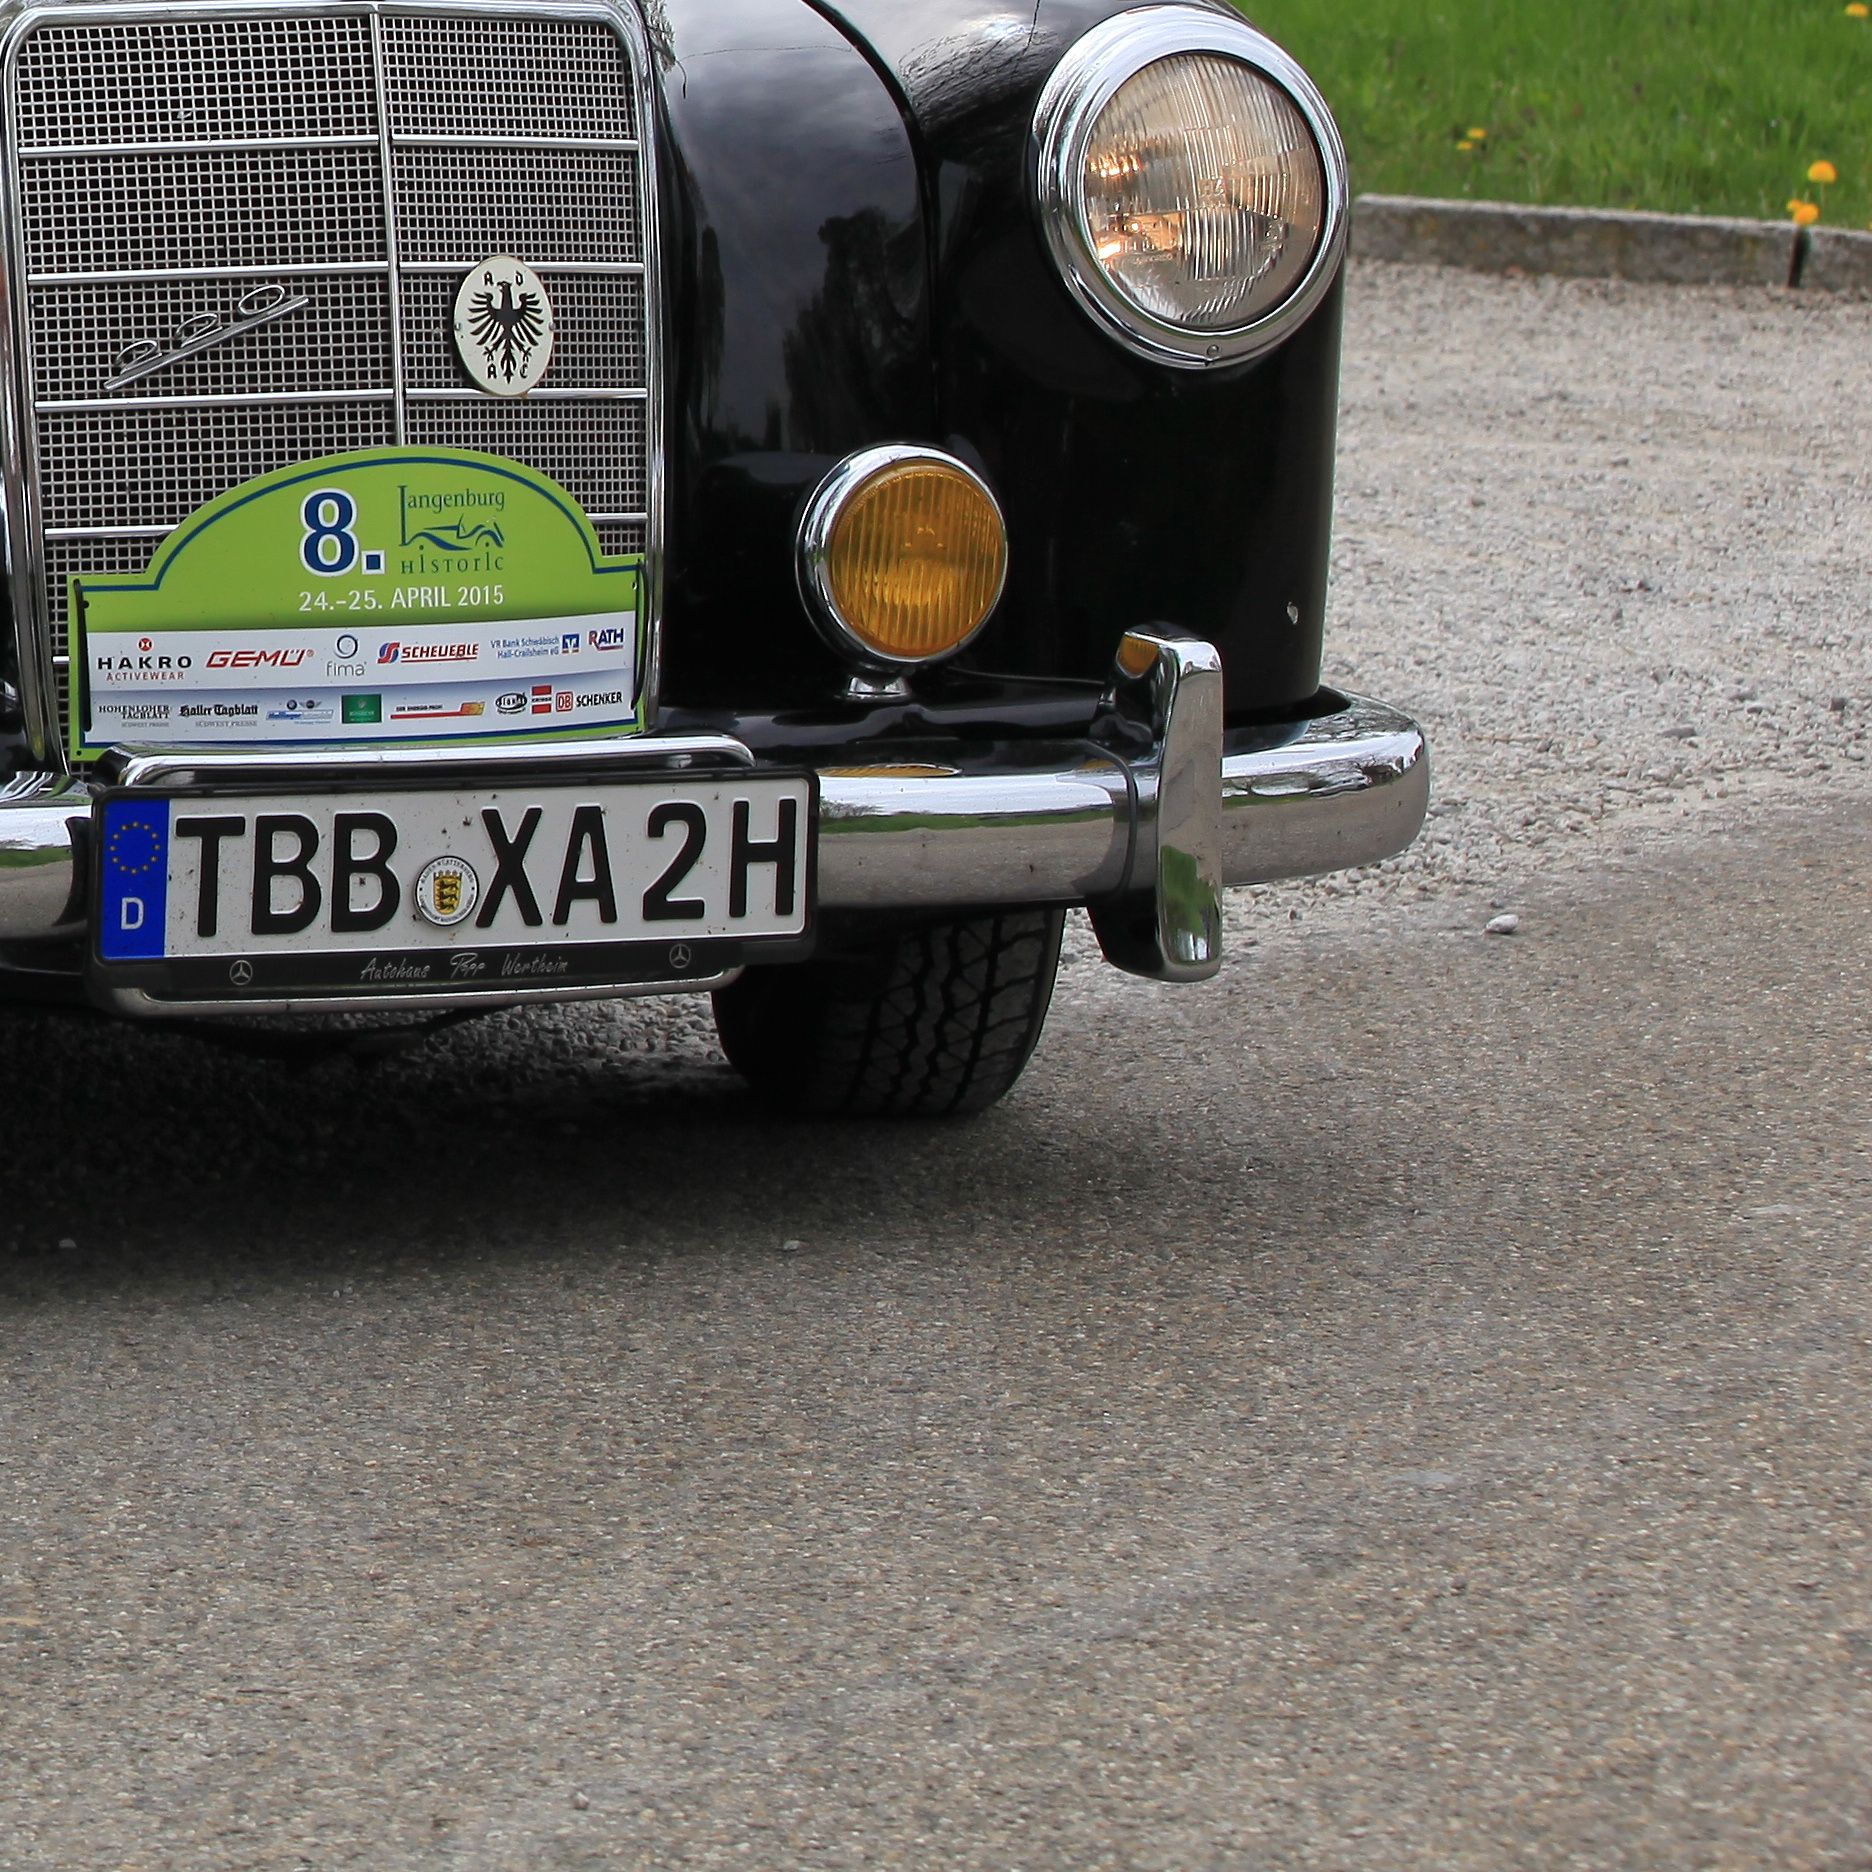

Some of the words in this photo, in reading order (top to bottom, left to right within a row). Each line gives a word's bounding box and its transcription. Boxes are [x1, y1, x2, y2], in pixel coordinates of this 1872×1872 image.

[397, 485, 505, 547] Langenburg
[300, 489, 386, 577] 8.
[299, 590, 383, 612] 24.-25.
[391, 586, 451, 609] APRIL
[458, 584, 504, 607] 2015
[589, 628, 624, 648] RATH
[97, 656, 192, 670] HAKRO
[206, 649, 306, 668] GEMÜ
[106, 672, 184, 681] ACTIVEWEAR
[326, 661, 365, 678] fima
[558, 698, 572, 709] DB
[575, 691, 623, 708] SCHENKER
[176, 810, 401, 940] TBB
[122, 897, 144, 930] D
[360, 957, 431, 980] Autohaus
[501, 953, 568, 976] Wertheim
